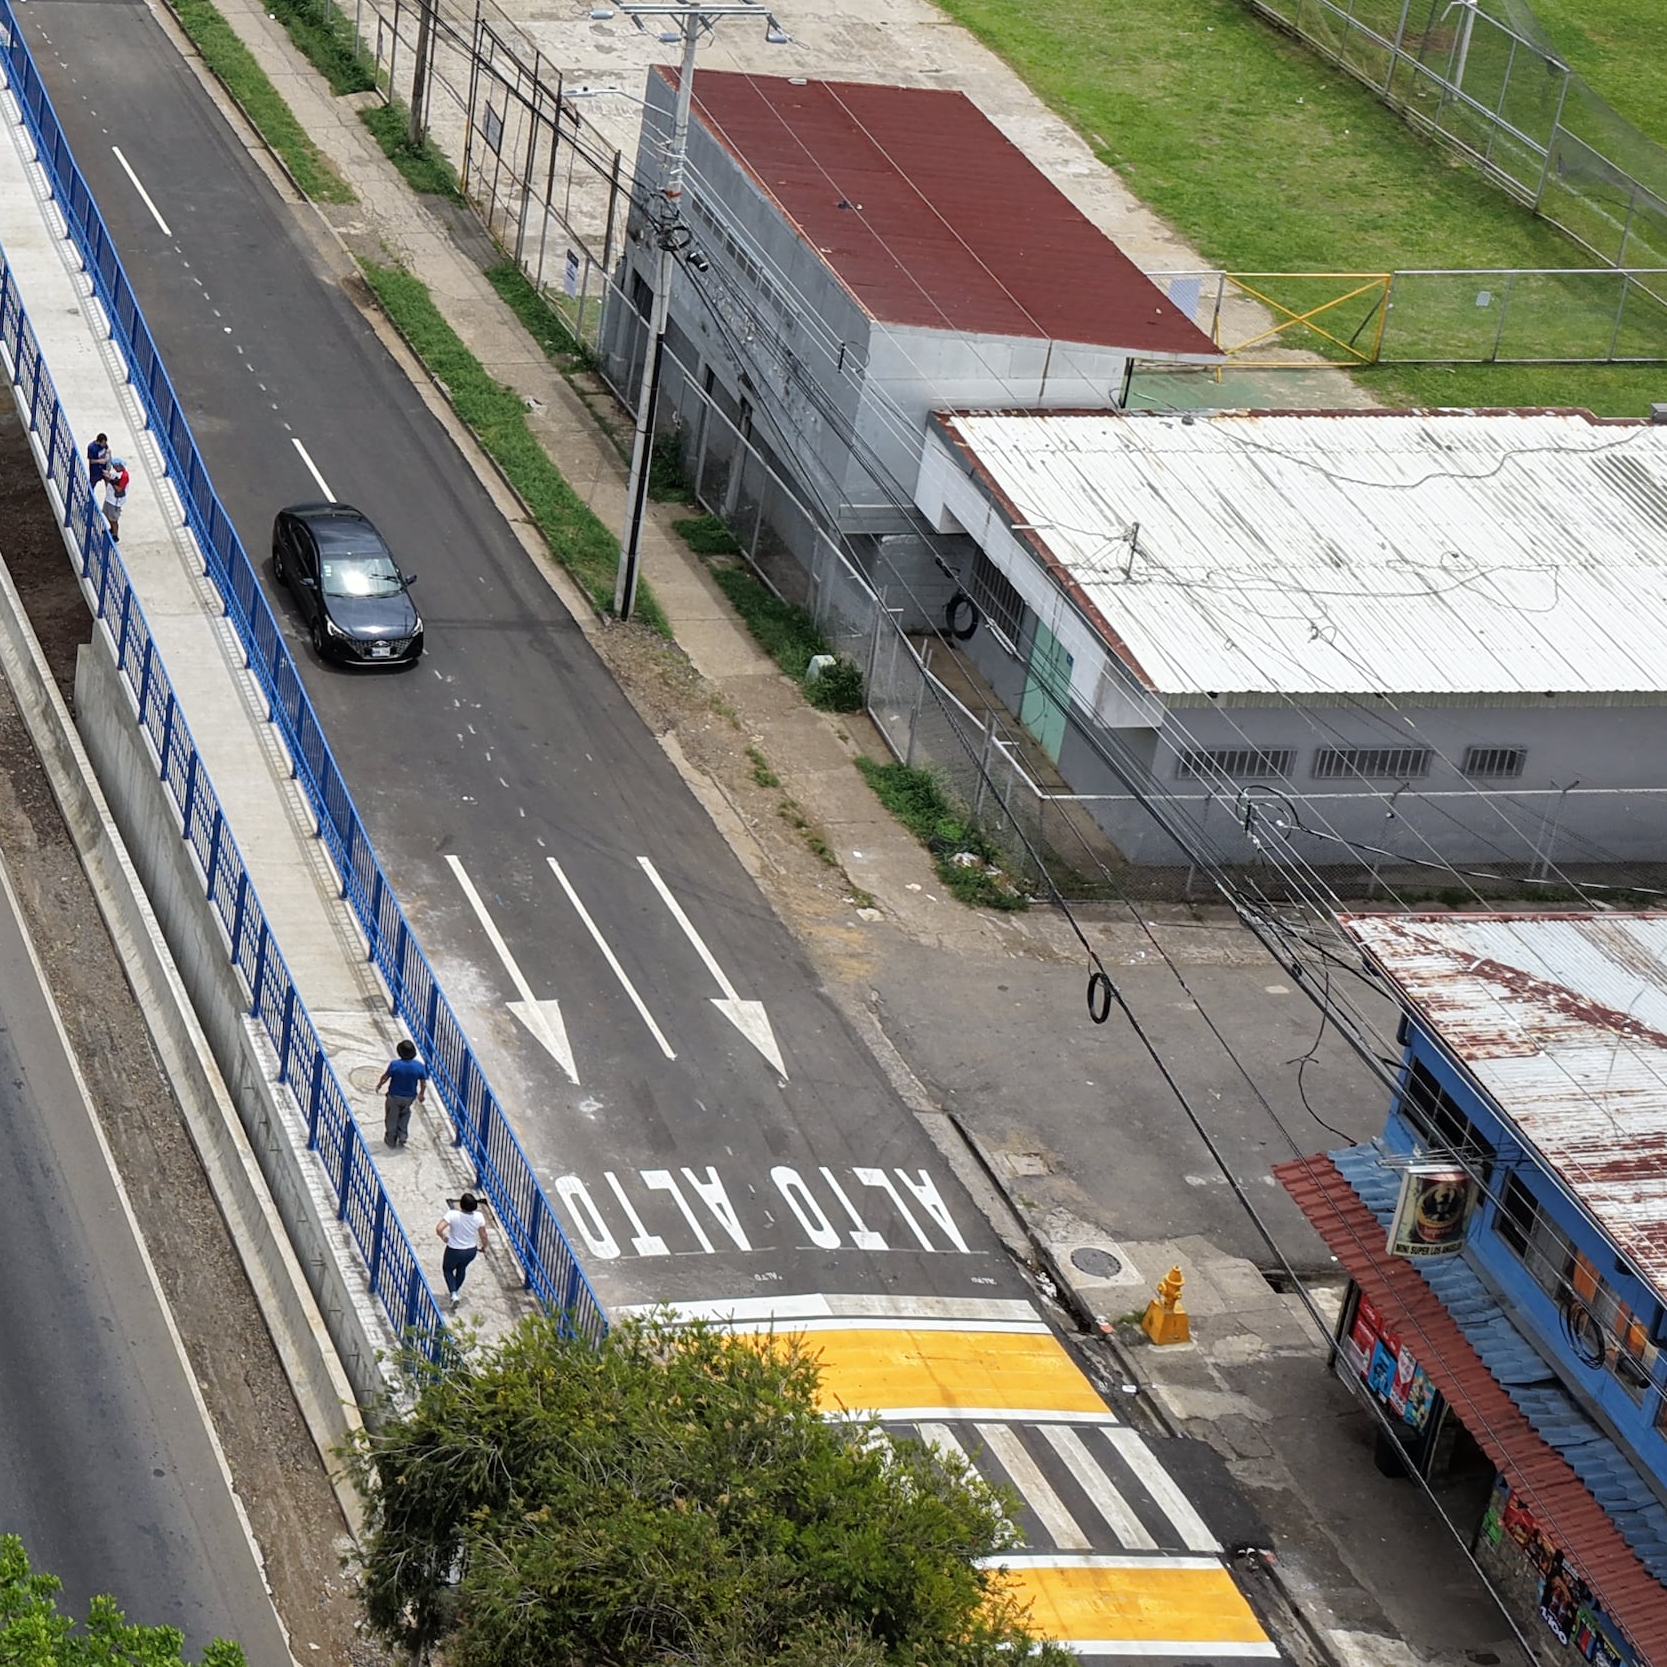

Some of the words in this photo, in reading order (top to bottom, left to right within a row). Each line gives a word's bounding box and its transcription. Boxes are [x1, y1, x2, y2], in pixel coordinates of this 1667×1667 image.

[555, 1166, 752, 1259] ALTO
[770, 1166, 970, 1254] ALTO
[1410, 1245, 1430, 1255] SUPER
[1430, 1244, 1442, 1254] LOS
